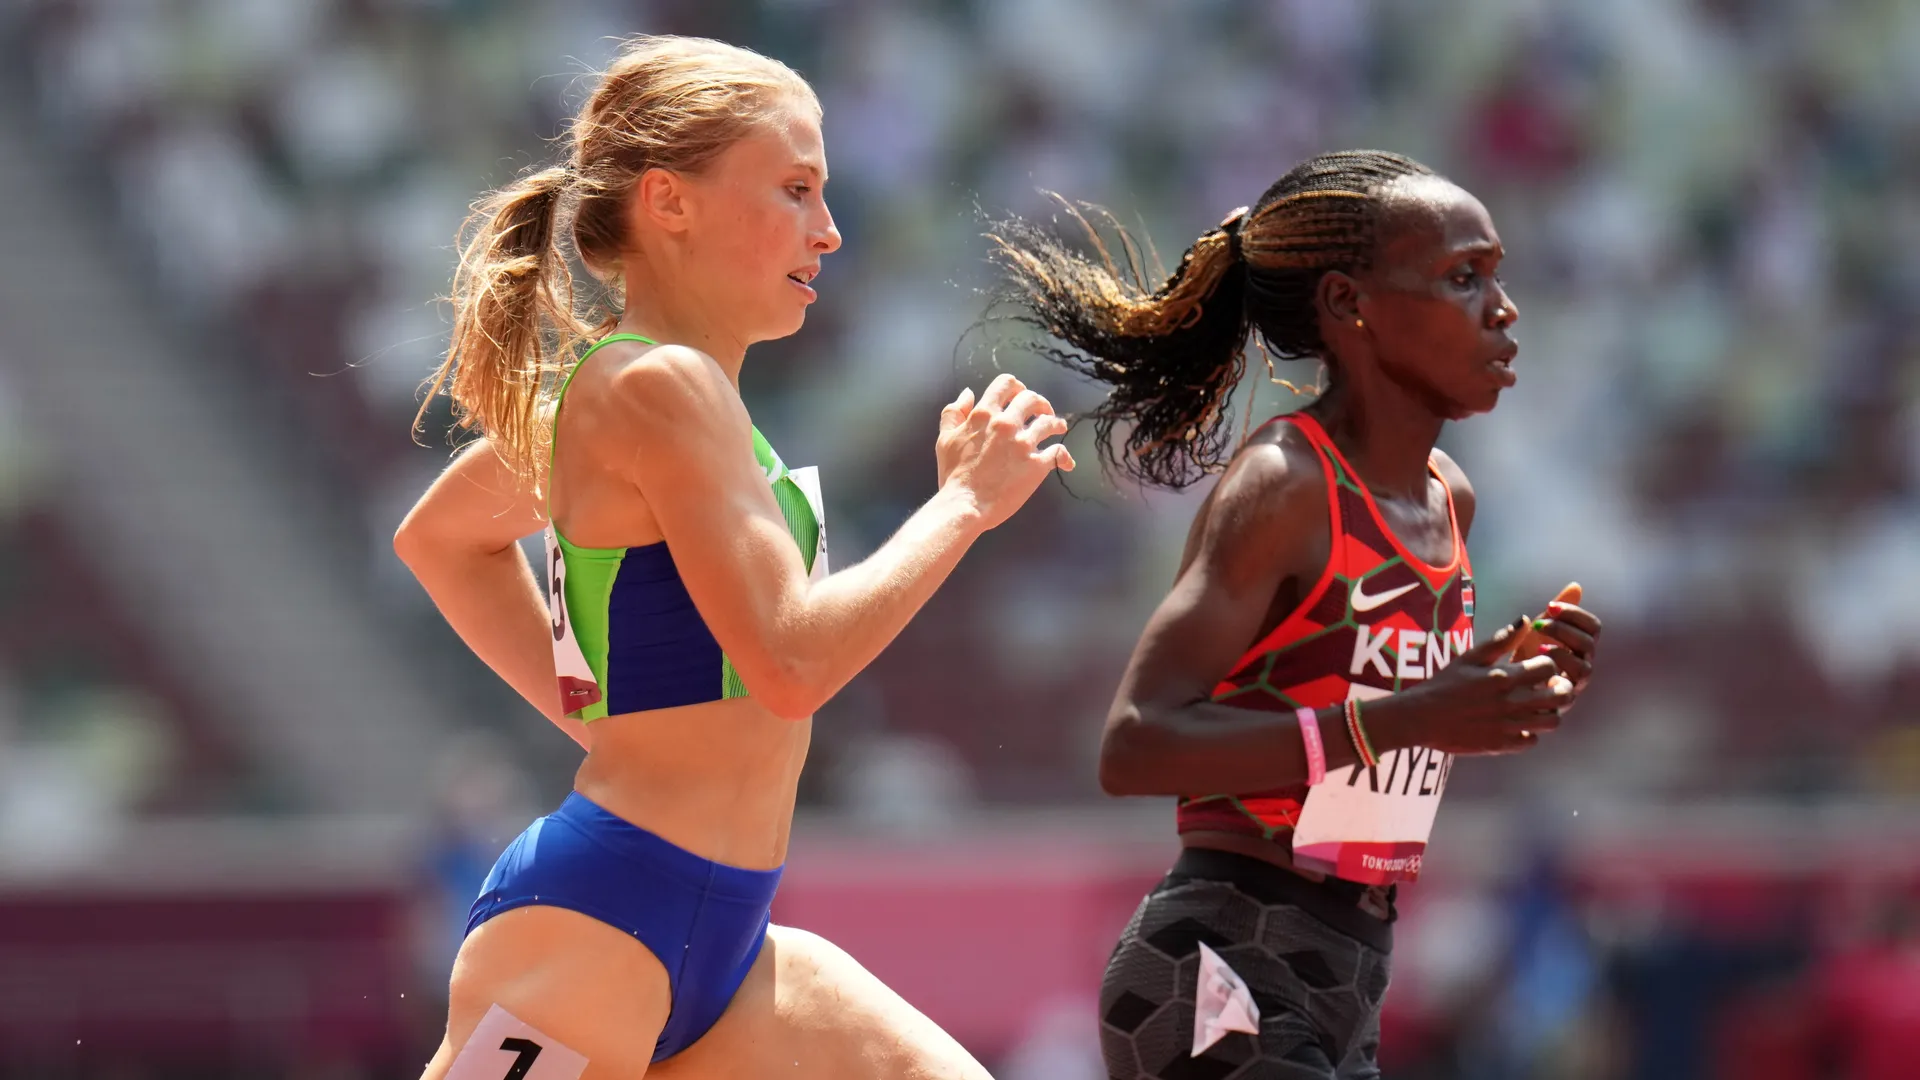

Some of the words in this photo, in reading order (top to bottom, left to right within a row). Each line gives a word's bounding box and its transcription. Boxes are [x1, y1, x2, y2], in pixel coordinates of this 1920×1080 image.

[552, 546, 566, 642] 5
[1350, 624, 1474, 679] KENY
[499, 1037, 543, 1080] 1
